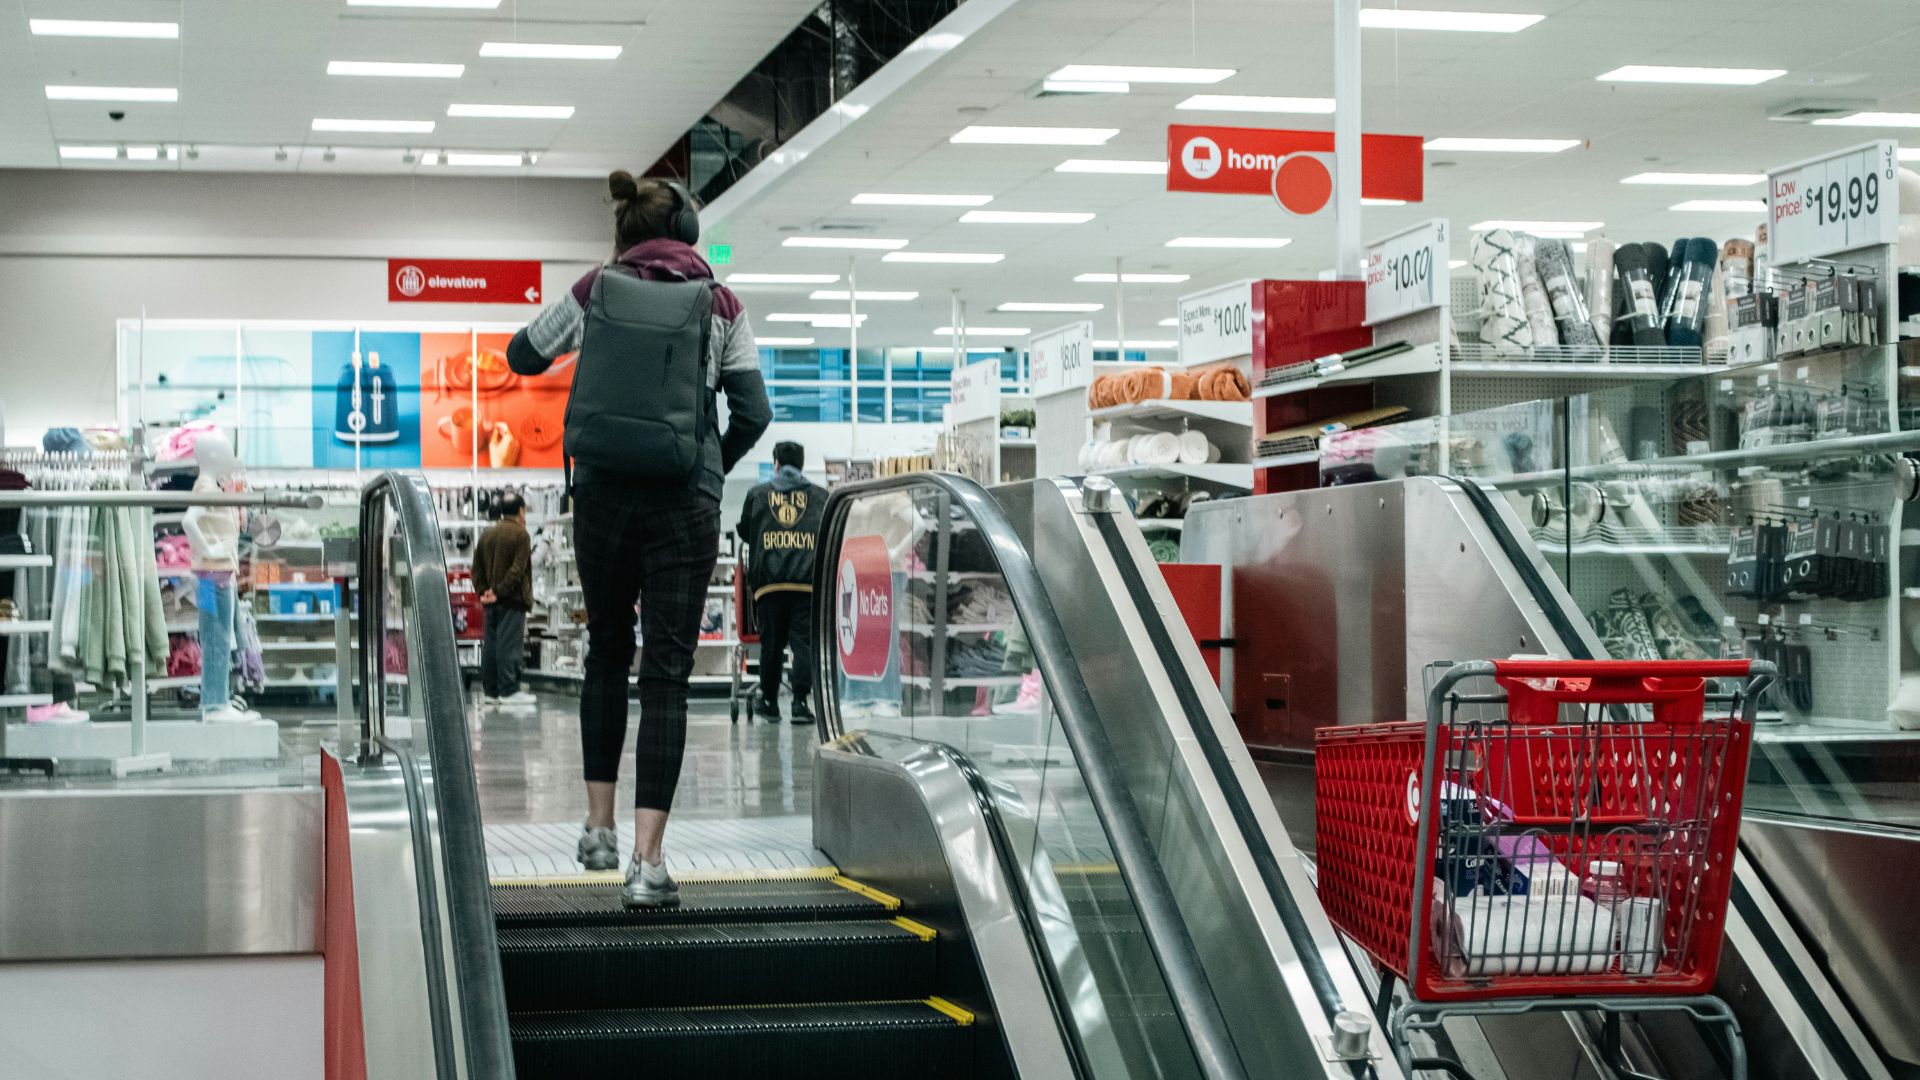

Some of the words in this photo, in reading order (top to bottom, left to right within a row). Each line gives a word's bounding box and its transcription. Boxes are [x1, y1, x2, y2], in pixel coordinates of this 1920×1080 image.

[1775, 180, 1796, 198] Low
[1806, 172, 1879, 226] $19.99
[1775, 195, 1802, 224] price!
[1368, 253, 1383, 268] Low
[428, 275, 487, 289] elevators
[763, 531, 815, 551] BROOKLYN
[859, 589, 869, 616] No
[870, 588, 889, 617] Carts
